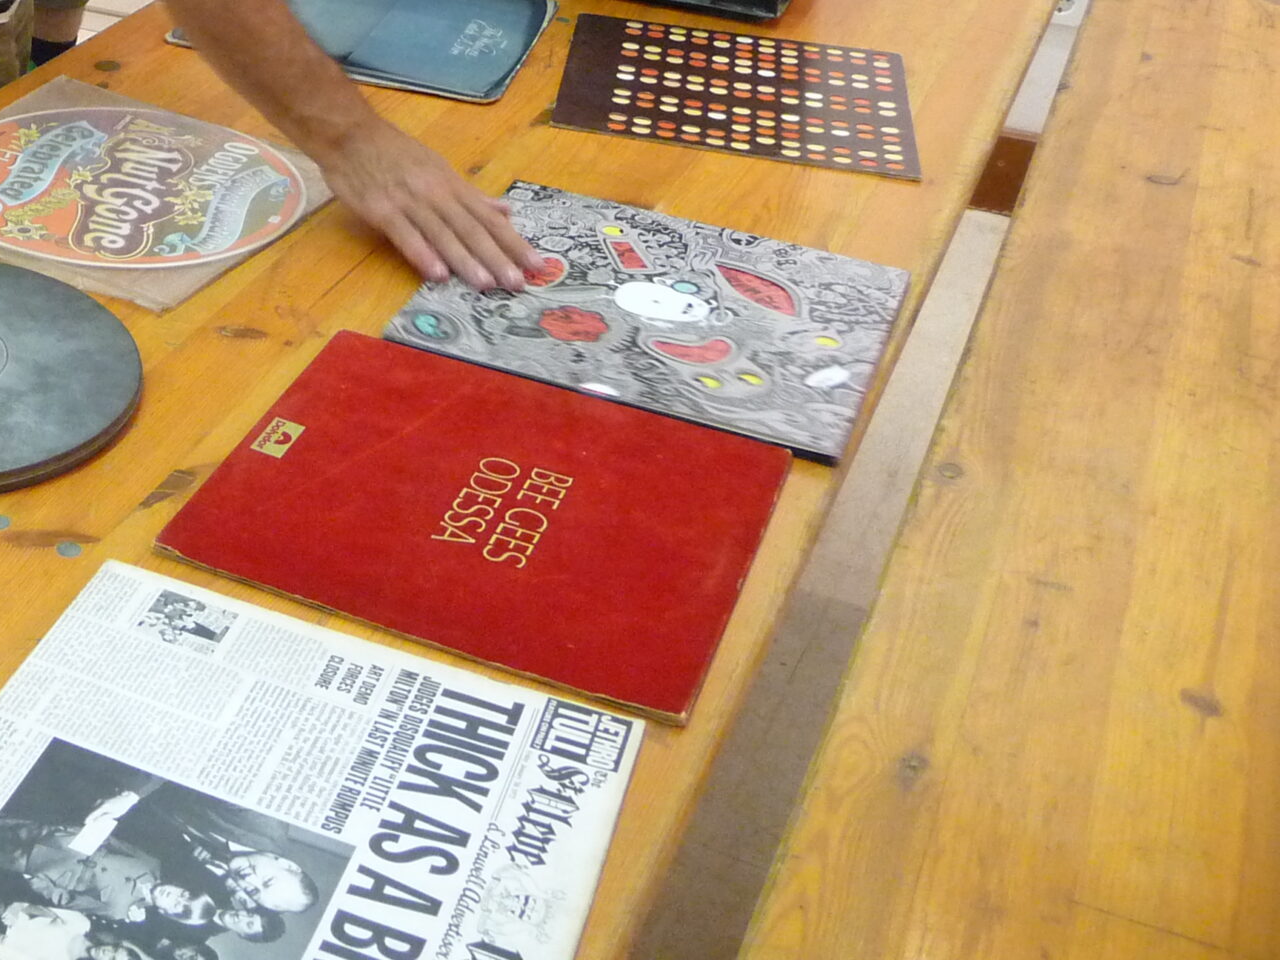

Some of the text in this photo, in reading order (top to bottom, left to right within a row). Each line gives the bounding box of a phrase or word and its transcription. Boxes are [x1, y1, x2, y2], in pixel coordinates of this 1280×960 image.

[430, 457, 521, 544] ODESSA
[482, 467, 574, 569] BEE GEES
[314, 654, 345, 690] CLOSURE
[336, 662, 364, 694] FORCES
[352, 664, 385, 706] ART DEMO
[408, 675, 442, 715] JUDGES
[365, 720, 394, 749] LAST
[377, 708, 400, 723] IN
[544, 708, 599, 755] TULL
[344, 746, 381, 787] MINUTE
[380, 713, 424, 773] DISQUALIFY
[398, 689, 524, 812] THICK
[586, 715, 627, 770] JETHRO
[321, 784, 362, 834] RUMPUS
[369, 801, 471, 876] AS
[346, 864, 443, 917] A
